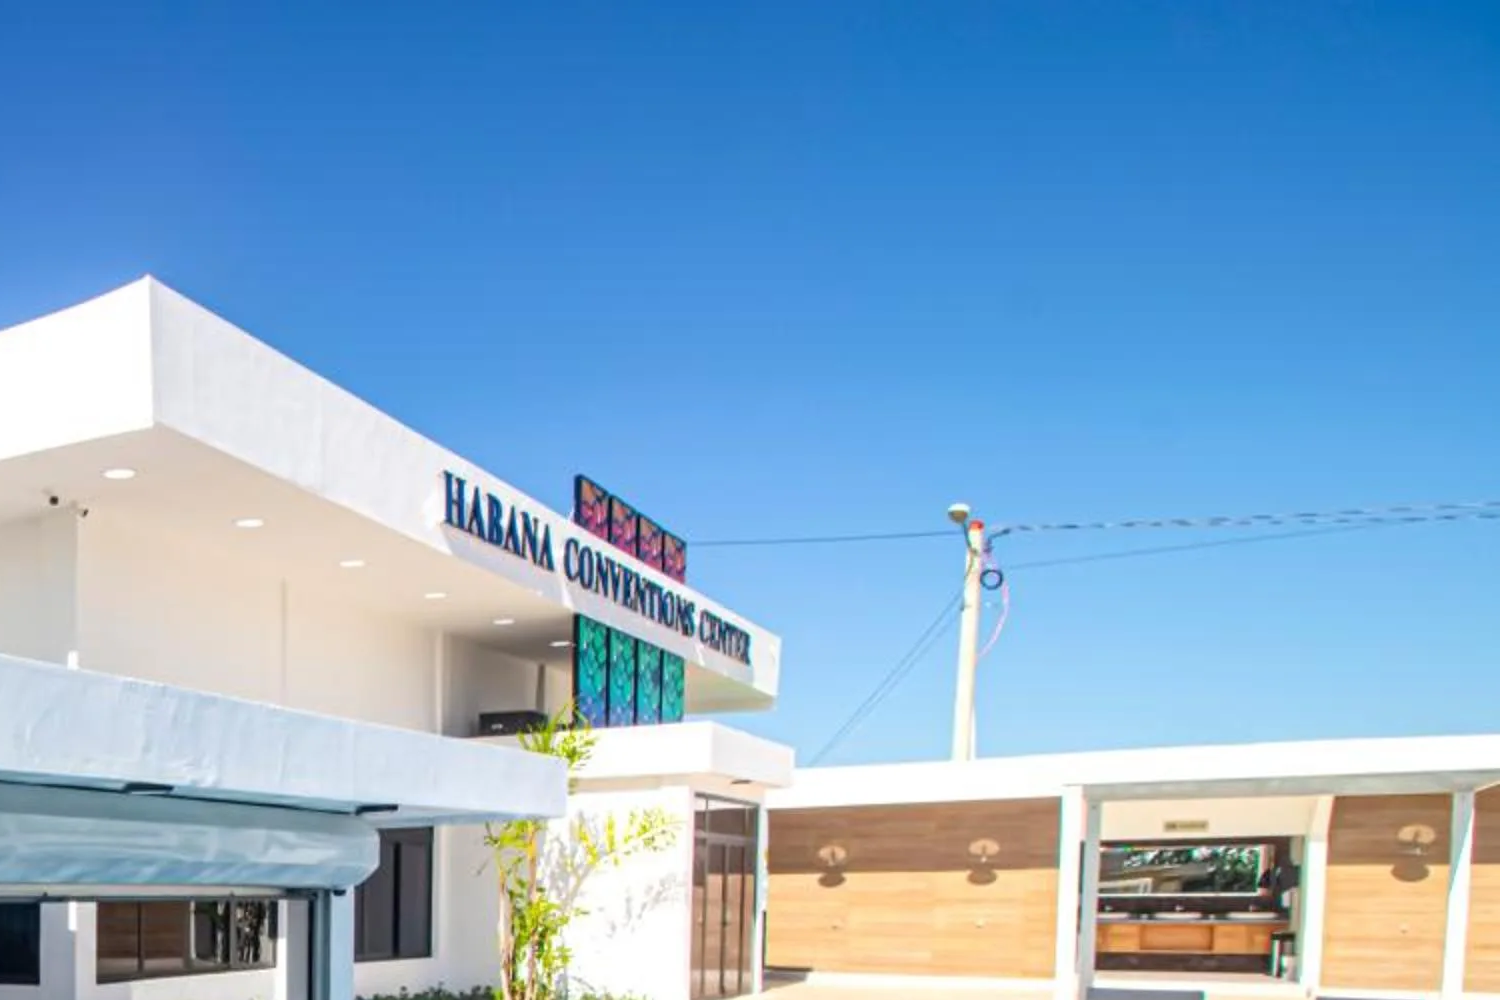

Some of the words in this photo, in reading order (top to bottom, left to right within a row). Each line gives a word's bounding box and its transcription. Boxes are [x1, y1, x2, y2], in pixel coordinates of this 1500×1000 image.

[443, 470, 554, 572] HABANA
[564, 537, 696, 637] CONVENTIONS
[699, 608, 751, 666] CENTER
